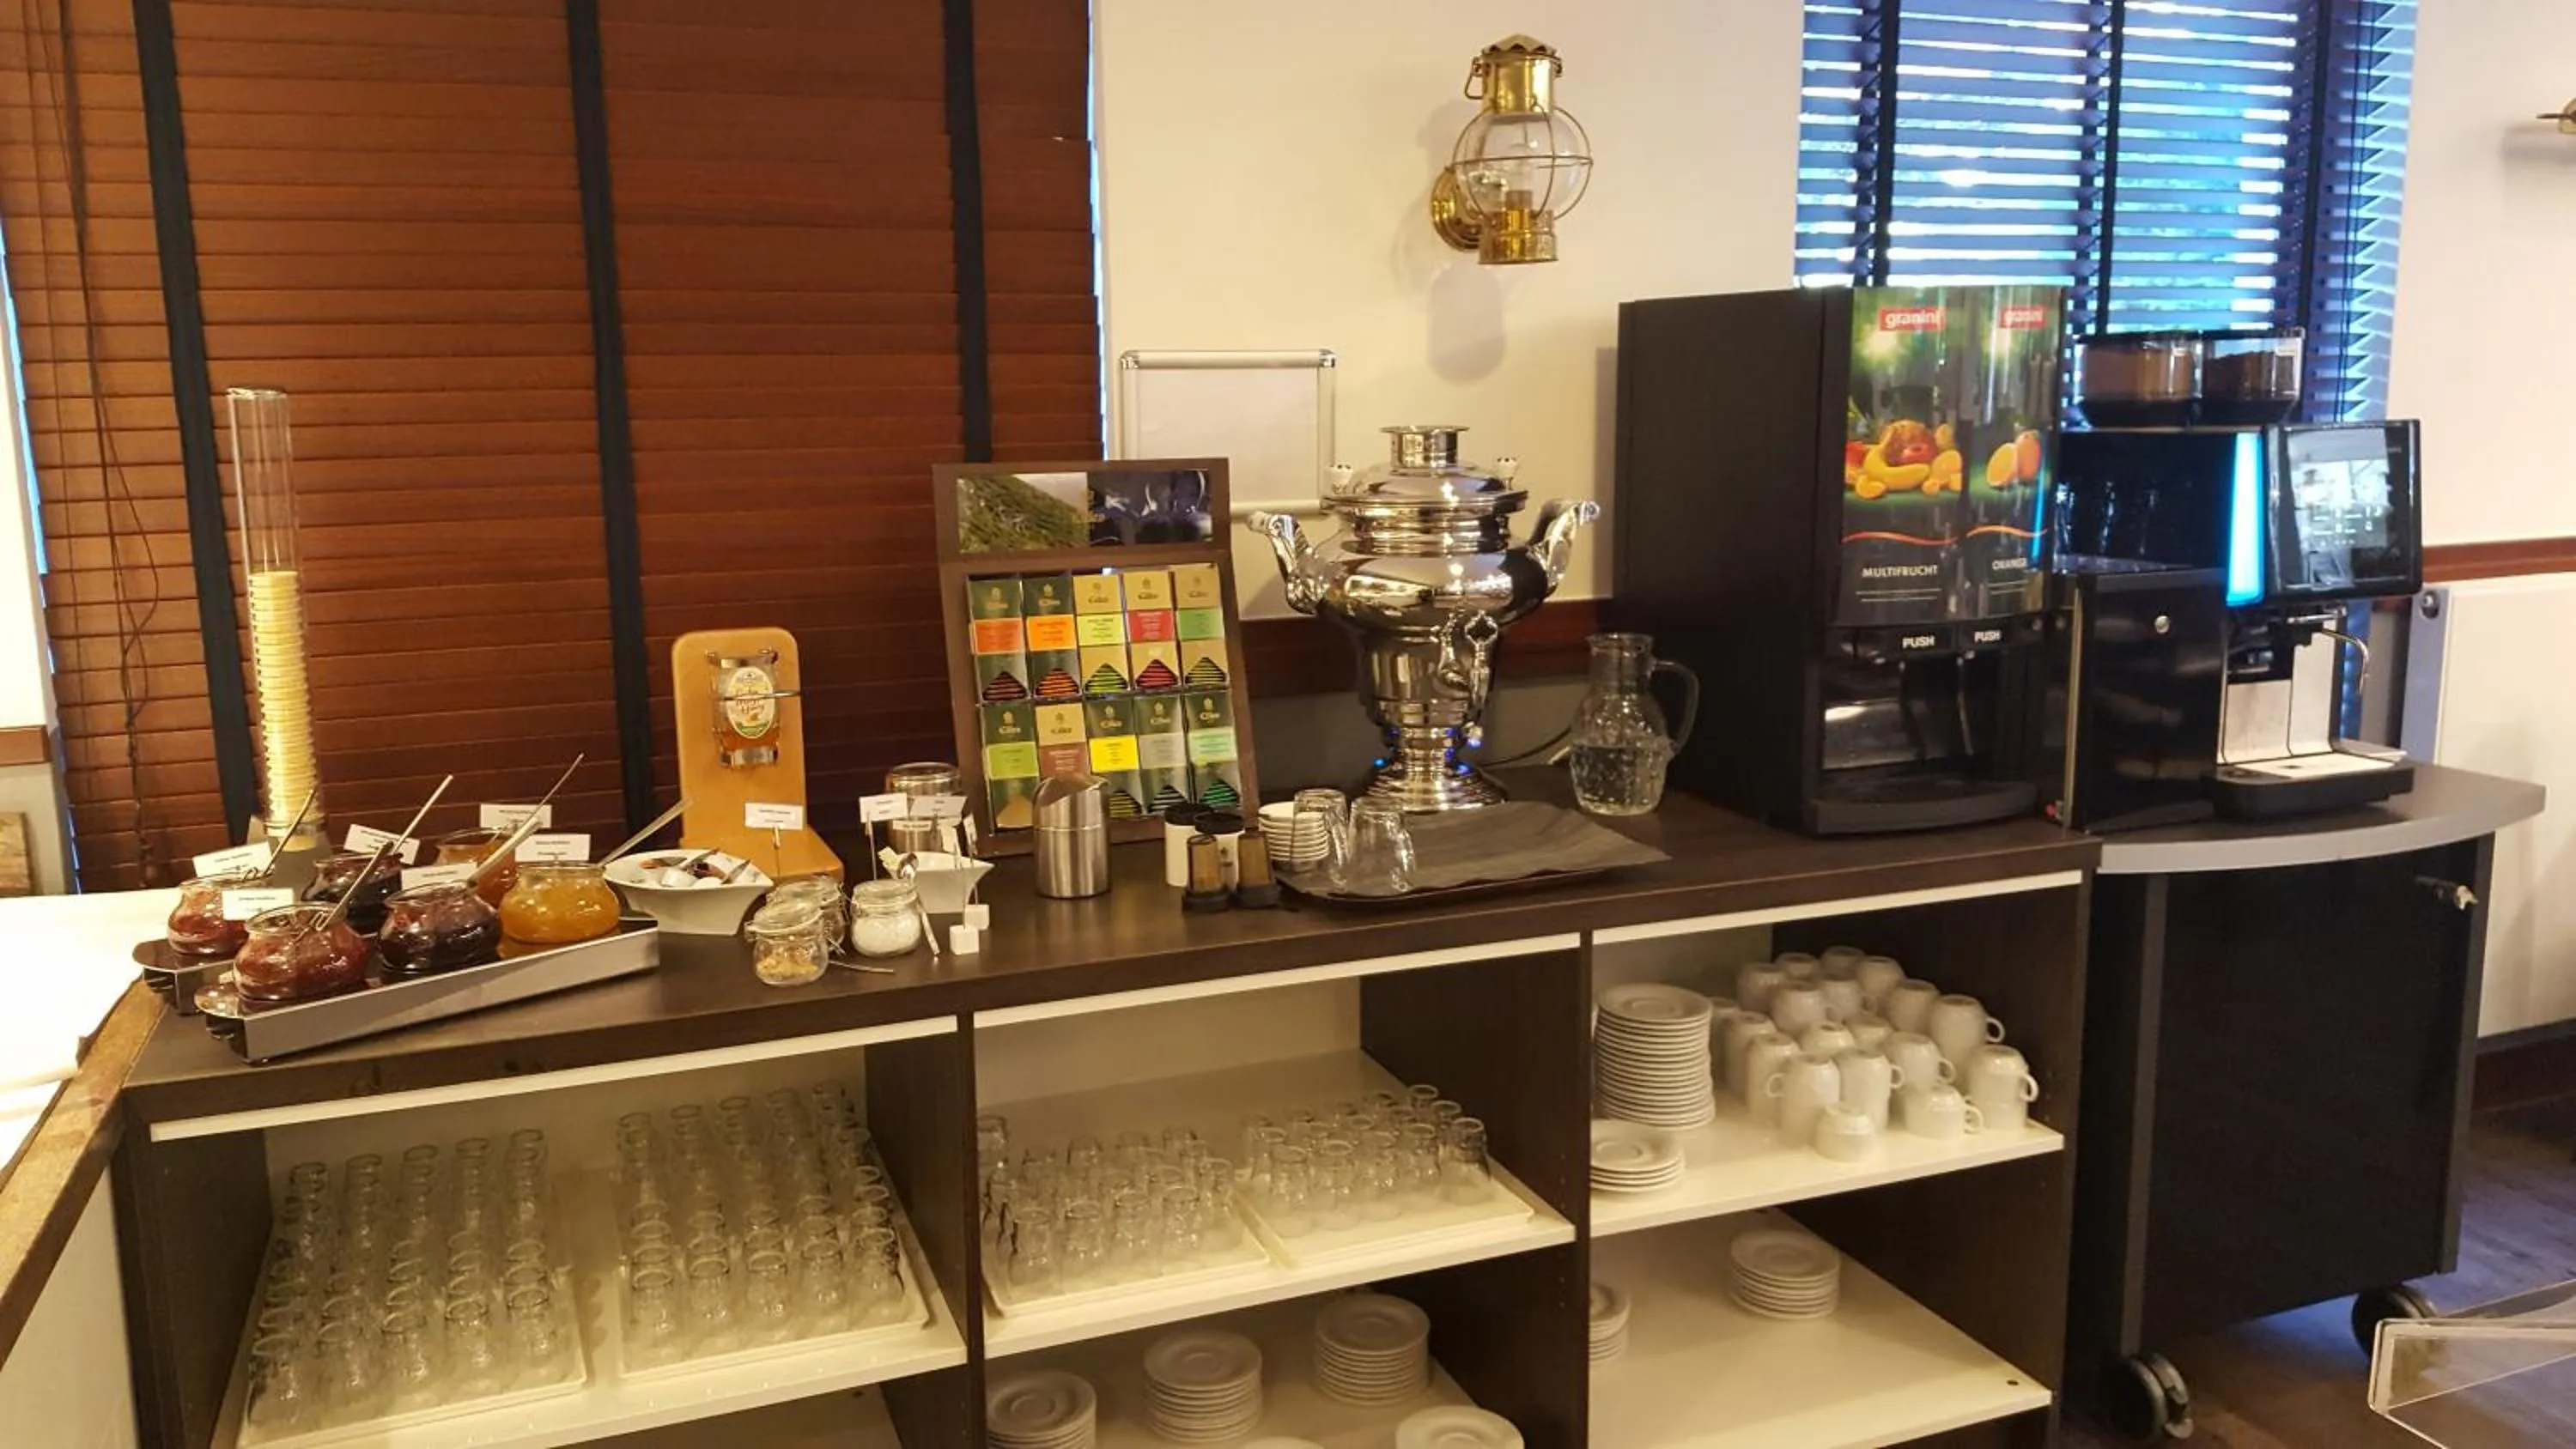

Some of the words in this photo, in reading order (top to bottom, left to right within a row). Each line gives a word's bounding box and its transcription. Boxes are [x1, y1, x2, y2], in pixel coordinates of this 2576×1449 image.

[1861, 564, 1939, 578] MULTIFRUCHT
[1902, 635, 1935, 649] PUSH
[1974, 630, 2002, 643] PUSH
